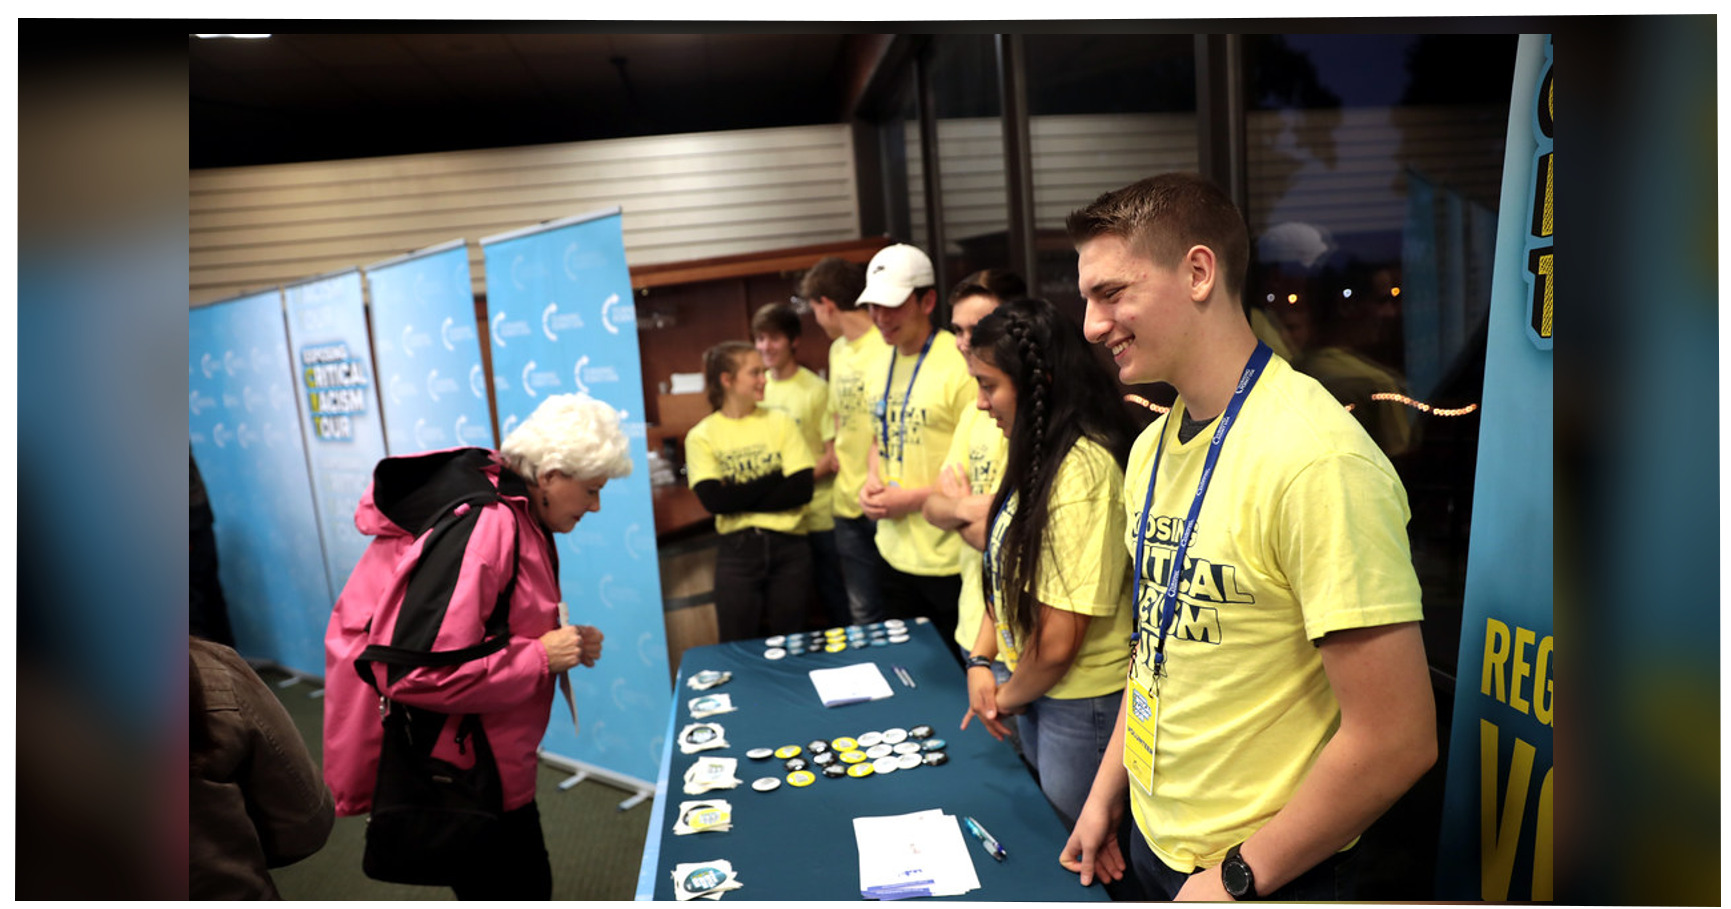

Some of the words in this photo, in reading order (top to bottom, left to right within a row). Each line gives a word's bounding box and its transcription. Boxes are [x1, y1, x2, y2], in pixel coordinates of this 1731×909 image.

[305, 362, 367, 388] CRITICAL
[314, 415, 351, 438] TOUR
[1480, 718, 1554, 902] V
